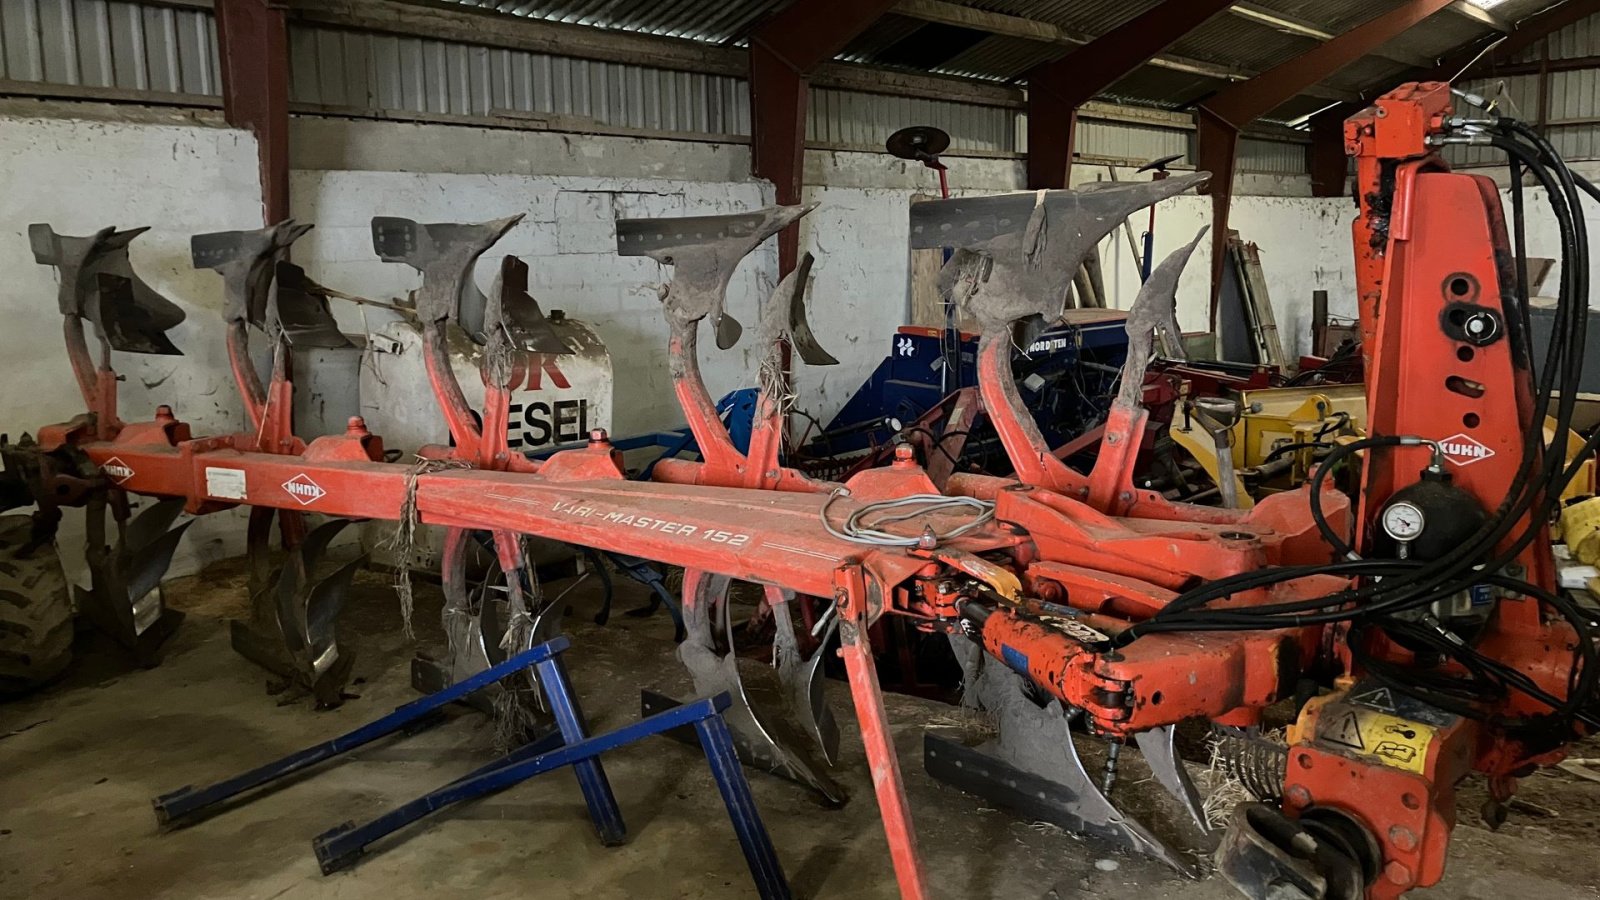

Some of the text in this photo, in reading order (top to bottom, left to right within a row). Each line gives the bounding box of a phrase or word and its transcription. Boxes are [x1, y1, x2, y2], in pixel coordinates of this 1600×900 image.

[1439, 442, 1486, 458] KUHN
[287, 481, 321, 497] KUHN
[552, 501, 749, 546] VARI-MASTER 152
